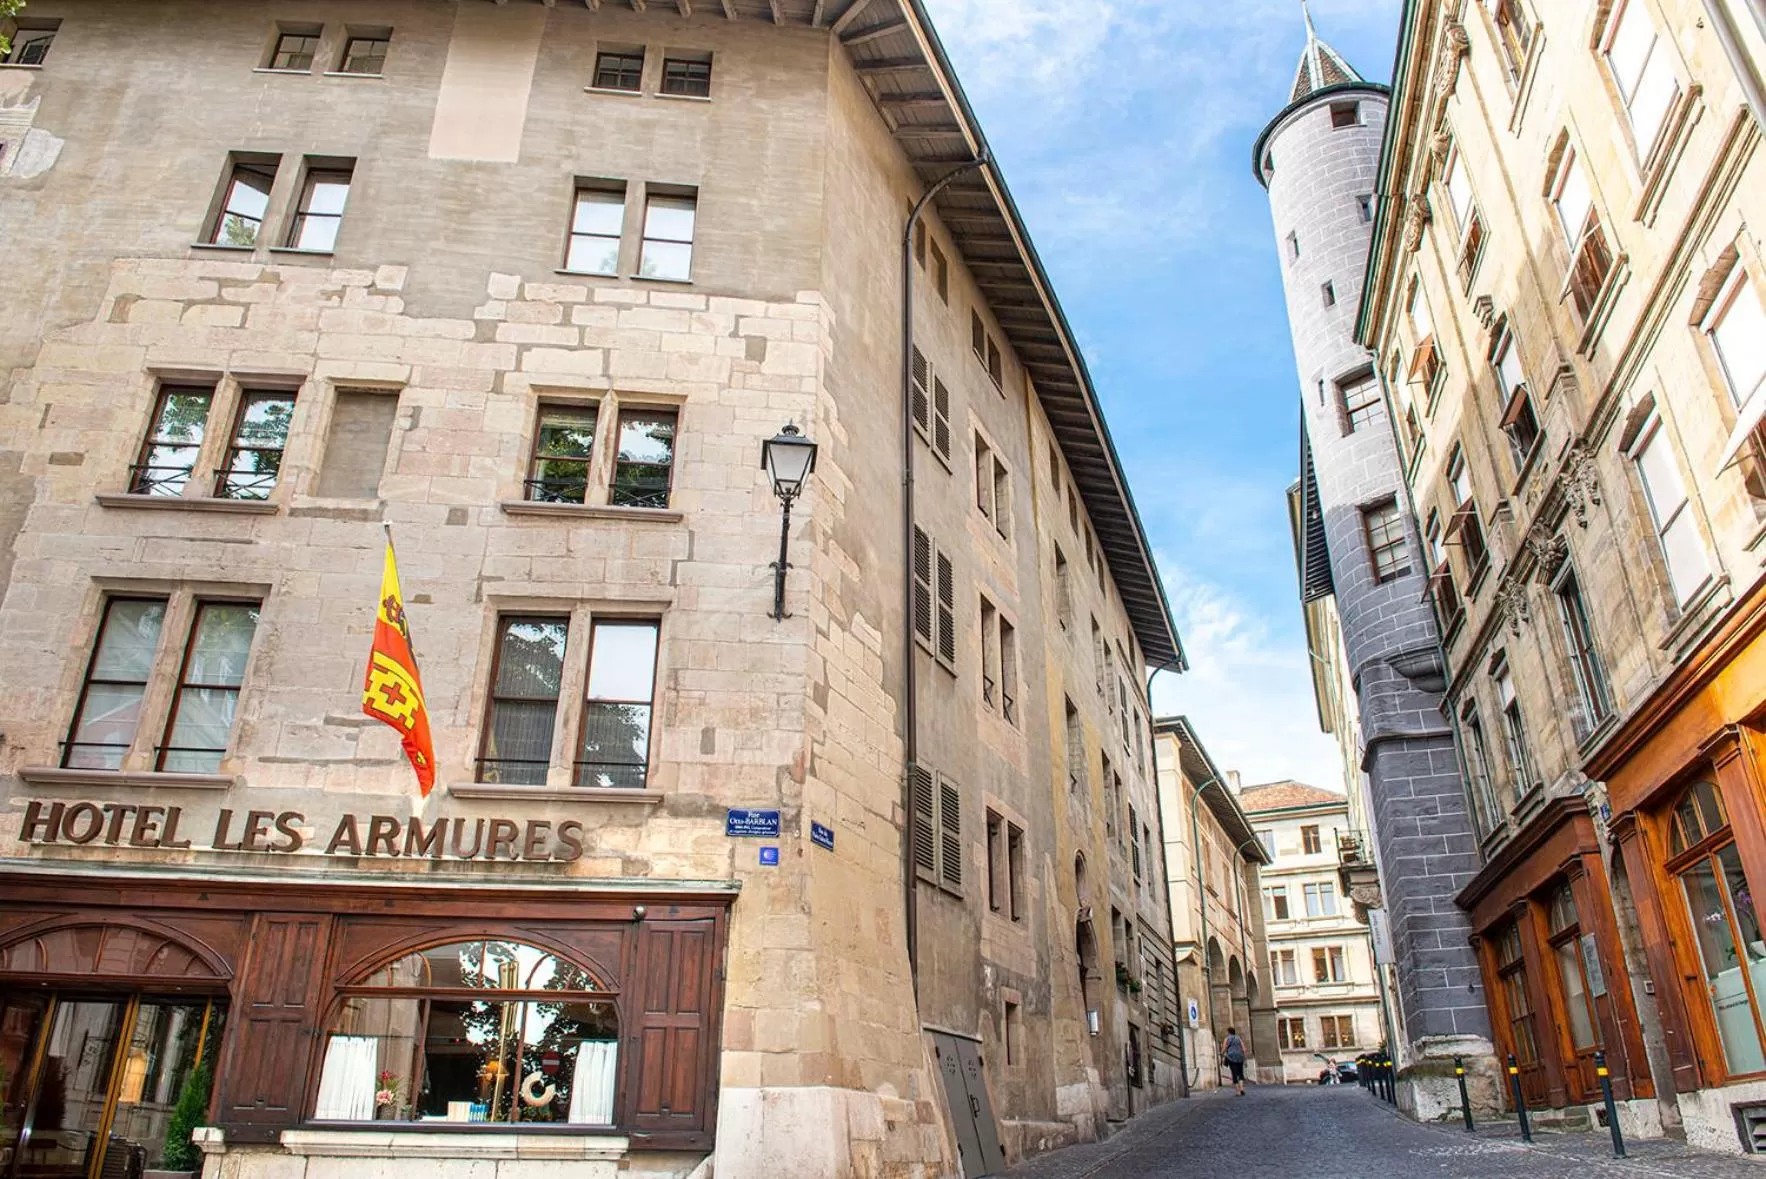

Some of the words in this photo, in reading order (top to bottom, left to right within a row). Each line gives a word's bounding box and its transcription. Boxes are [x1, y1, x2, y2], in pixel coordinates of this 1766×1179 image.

[19, 801, 192, 849] HOTEL
[212, 808, 305, 852] LES
[324, 813, 584, 862] ARMURES
